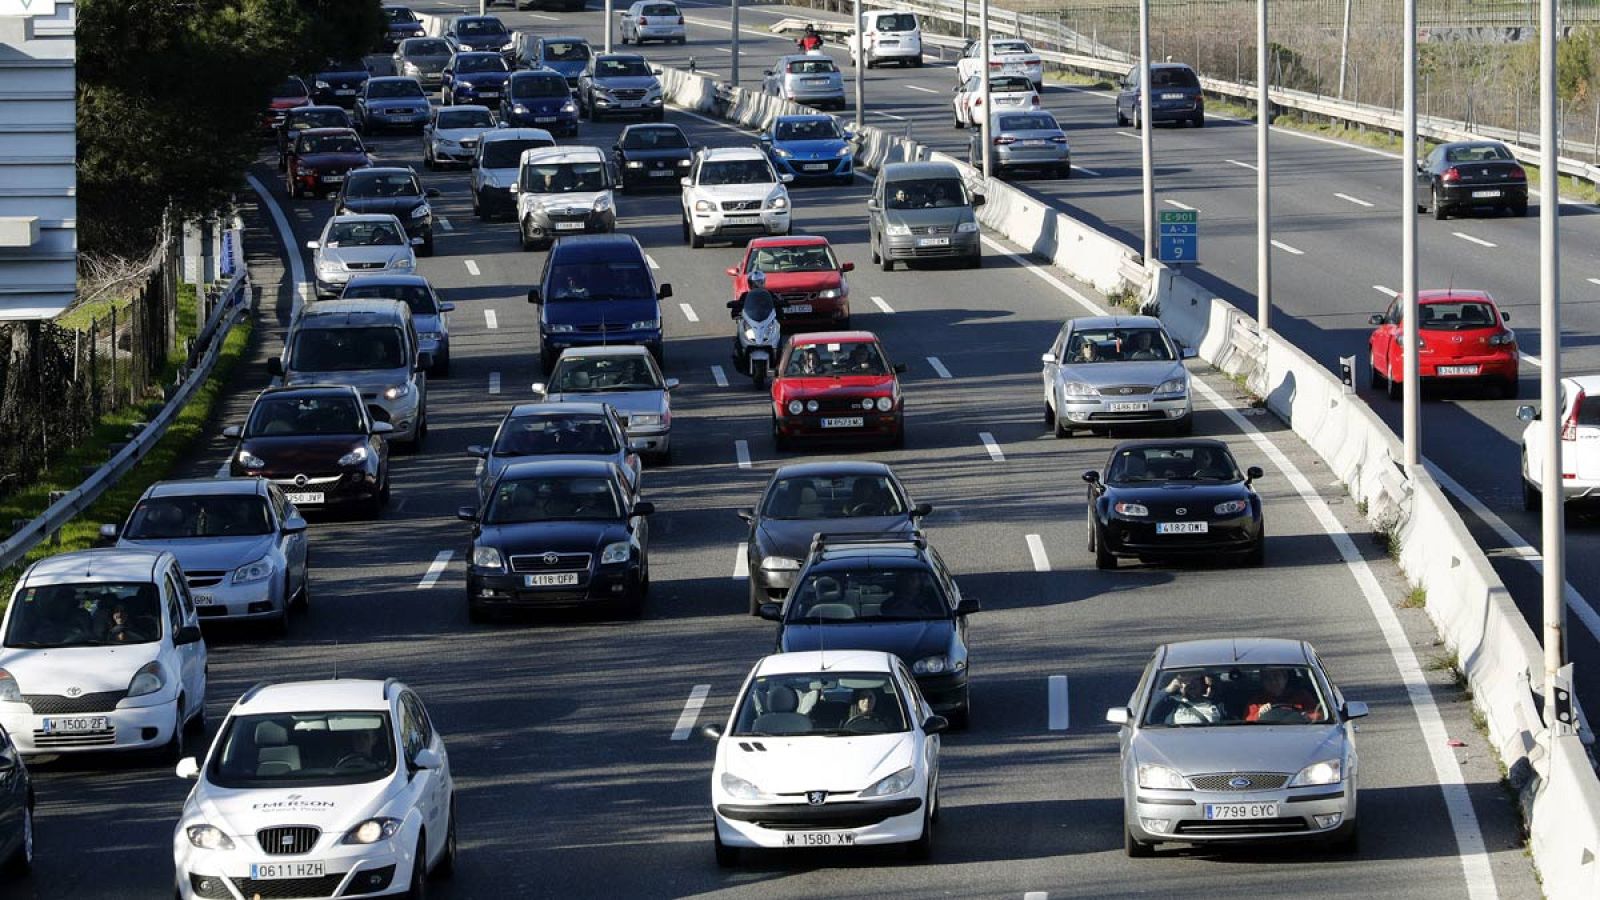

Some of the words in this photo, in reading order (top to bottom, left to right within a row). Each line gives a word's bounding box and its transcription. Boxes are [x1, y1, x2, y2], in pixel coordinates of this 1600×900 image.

[1170, 225, 1188, 233] A-3
[1174, 247, 1184, 259] 9
[1164, 523, 1186, 532] 4182
[63, 719, 88, 730] 1500
[252, 801, 335, 810] EMERSON
[1215, 805, 1246, 818] 7799
[787, 833, 796, 845] M
[803, 834, 831, 845] 1580
[260, 864, 293, 877] 0611
[297, 863, 323, 876] HZH
